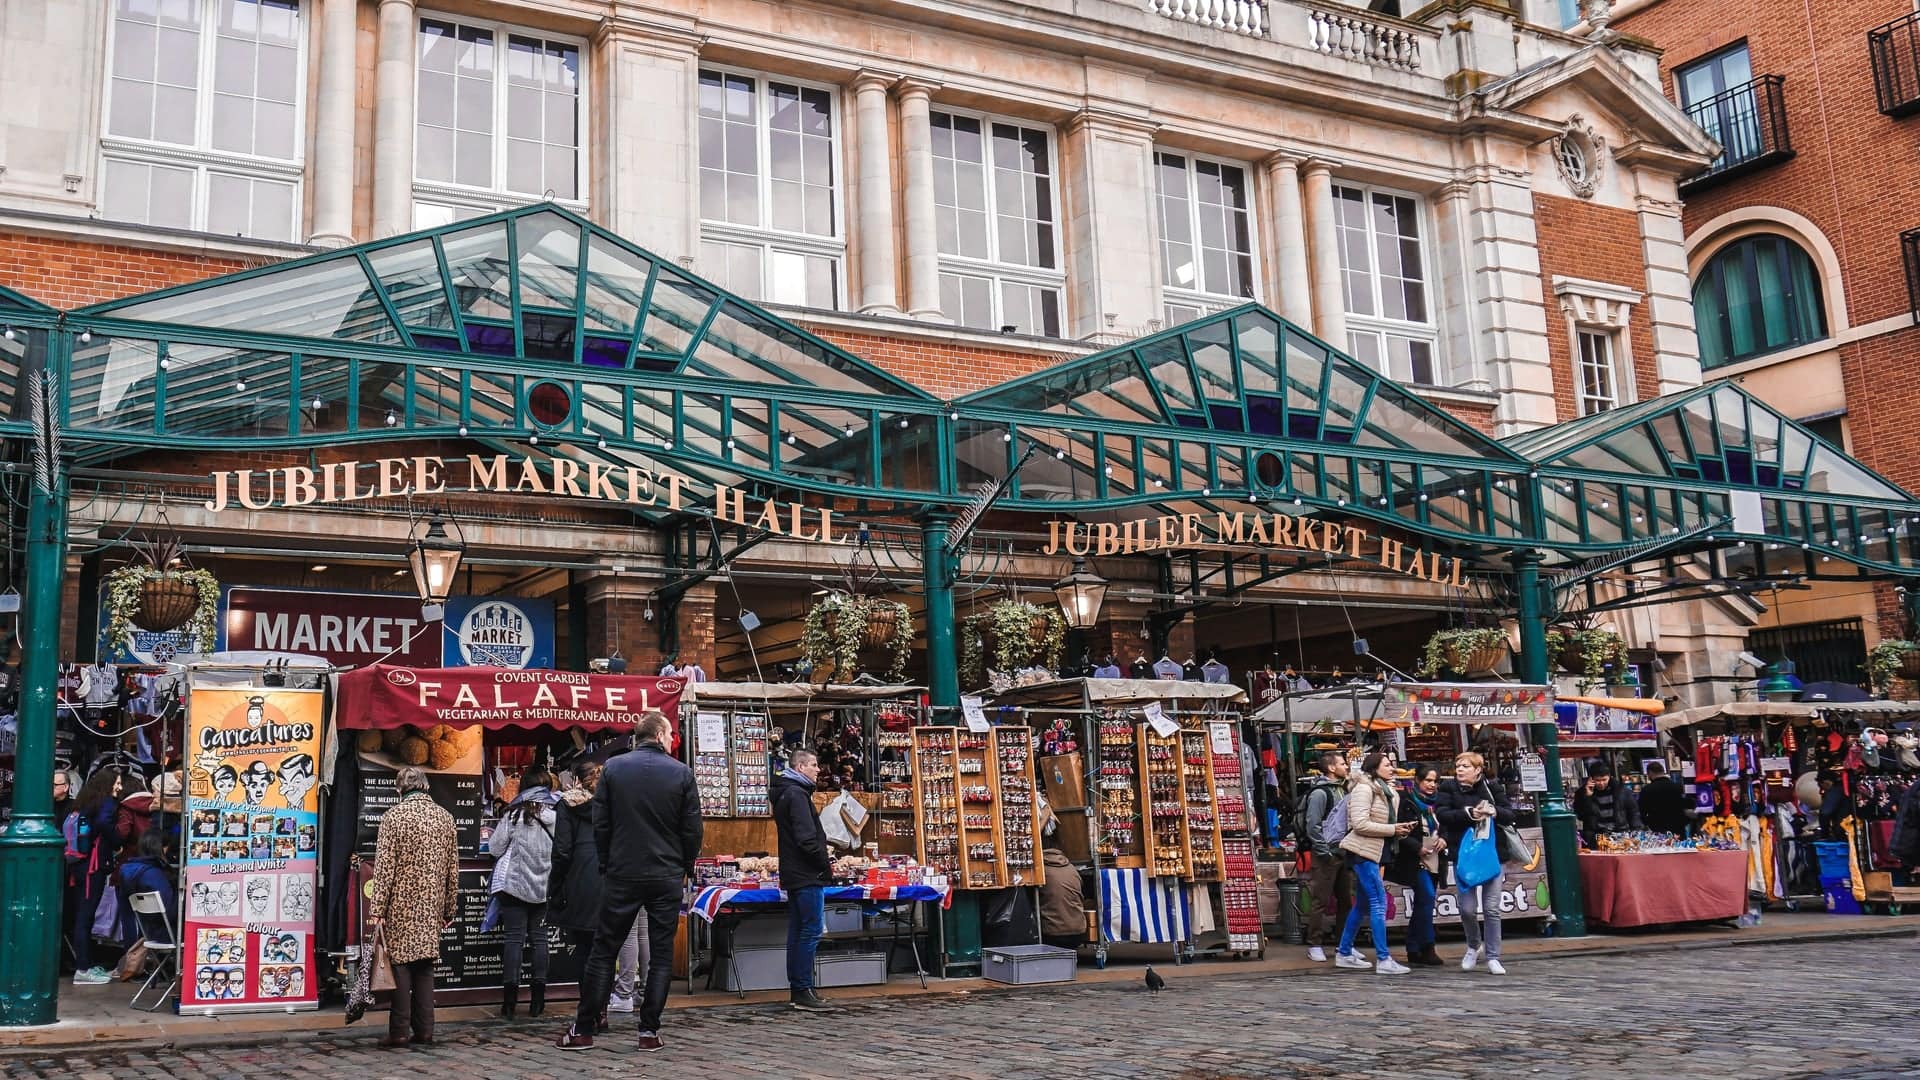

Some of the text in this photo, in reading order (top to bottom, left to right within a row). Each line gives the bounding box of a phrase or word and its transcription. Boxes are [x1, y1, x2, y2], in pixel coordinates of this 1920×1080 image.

[204, 454, 847, 545] JUBILEE MARKET HALL
[1043, 511, 1470, 588] JUBILEE MARKET HALL
[471, 614, 522, 632] JUBILEE
[254, 612, 418, 654] MARKET
[471, 629, 522, 644] MARKET
[495, 672, 589, 685] COVENT GARDEN
[419, 682, 661, 712] FALAFEL
[436, 708, 643, 723] VEGETARIAN & MEDITERRANEAN FOO
[1423, 701, 1518, 716] Fruit Market
[200, 719, 313, 749] Caricatures
[210, 859, 286, 875] Black and White
[466, 895, 480, 903] The
[246, 922, 282, 936] Colour
[465, 925, 479, 933] The
[479, 953, 501, 962] Greek
